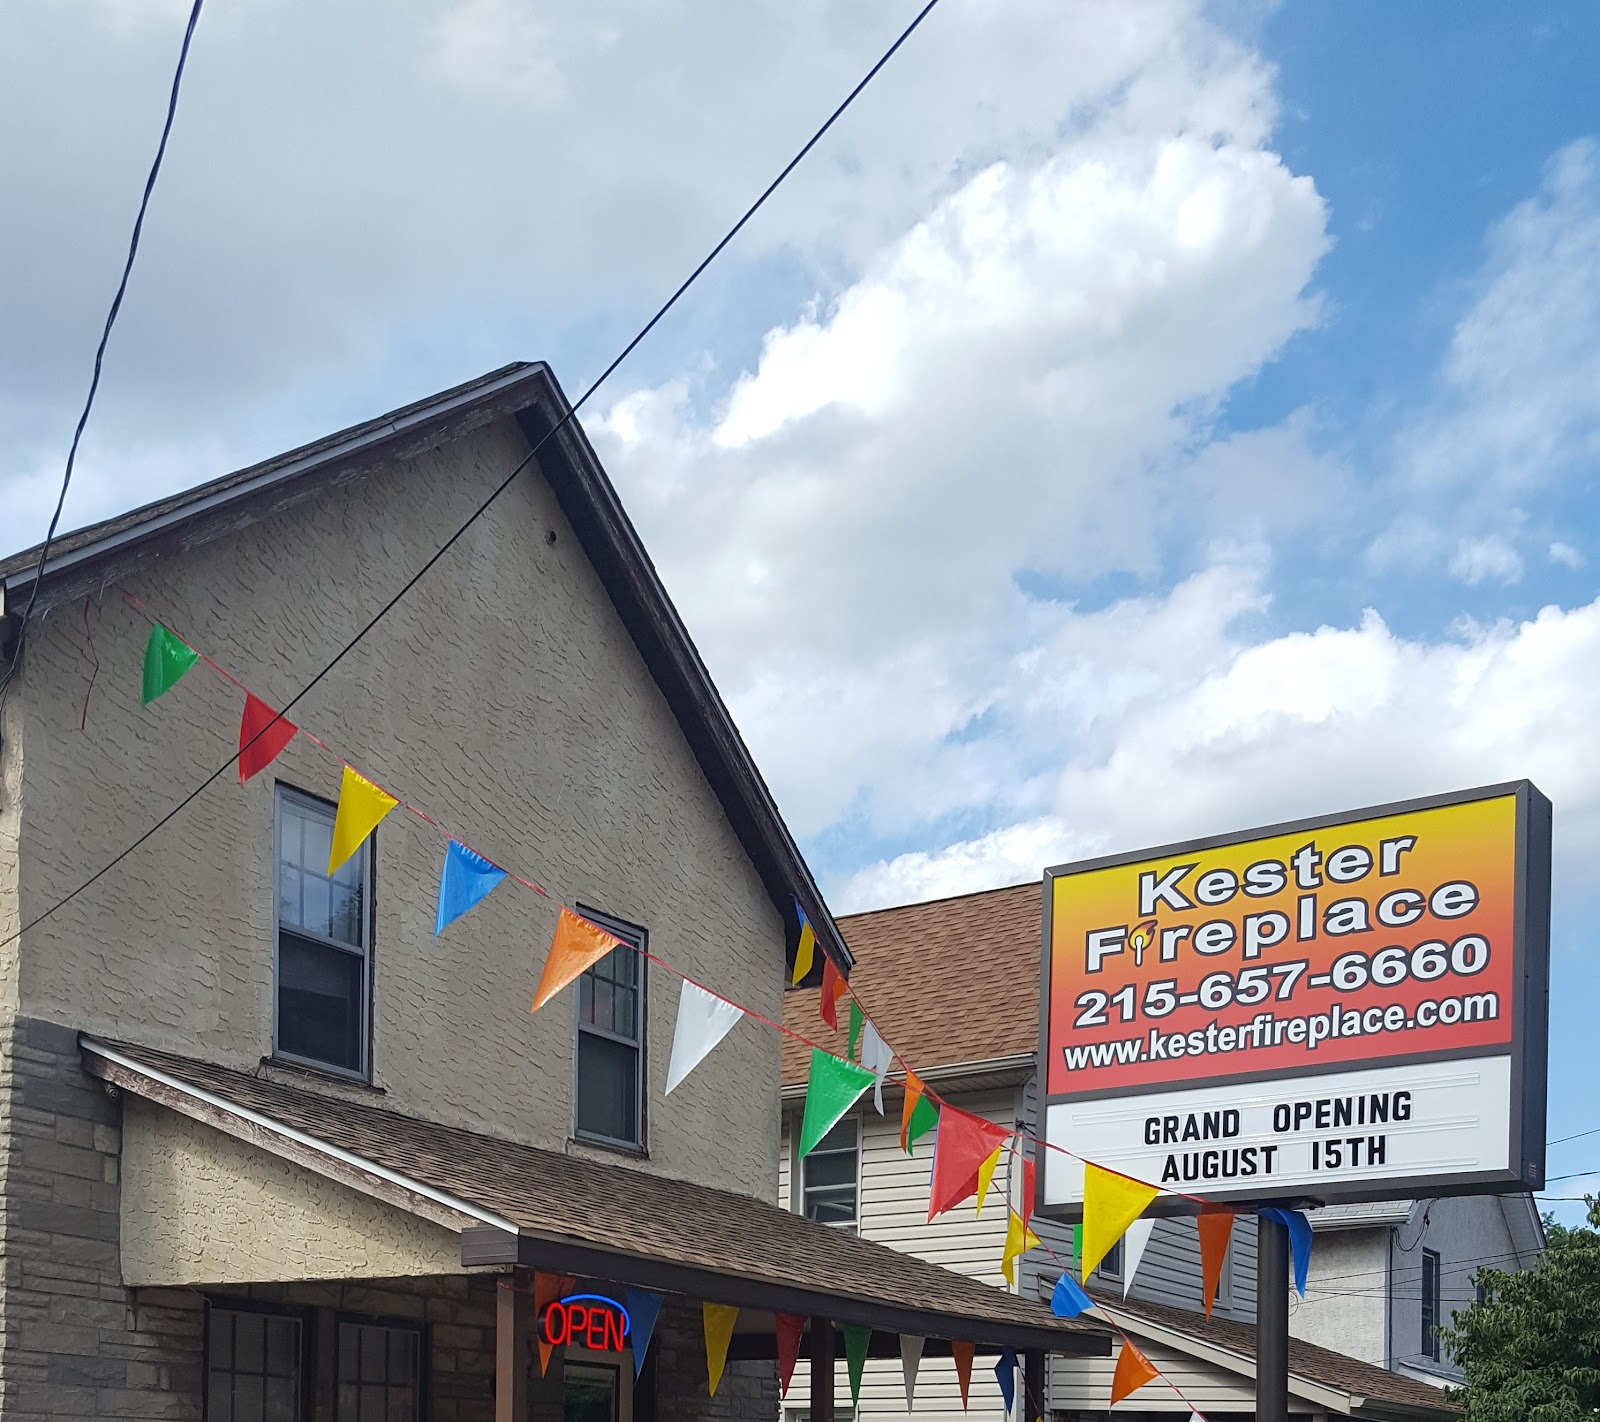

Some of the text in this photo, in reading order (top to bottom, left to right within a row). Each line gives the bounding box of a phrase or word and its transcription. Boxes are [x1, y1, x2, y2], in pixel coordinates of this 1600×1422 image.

[1138, 835, 1418, 917] Kester
[1072, 934, 1490, 1028] 215-657-6660
[1063, 991, 1498, 1071] www.kesterfireplace.com
[1144, 1091, 1412, 1146] GRAND OPENING
[1161, 1135, 1387, 1184] AUGUST 15TH
[544, 1301, 625, 1352] OPEN
